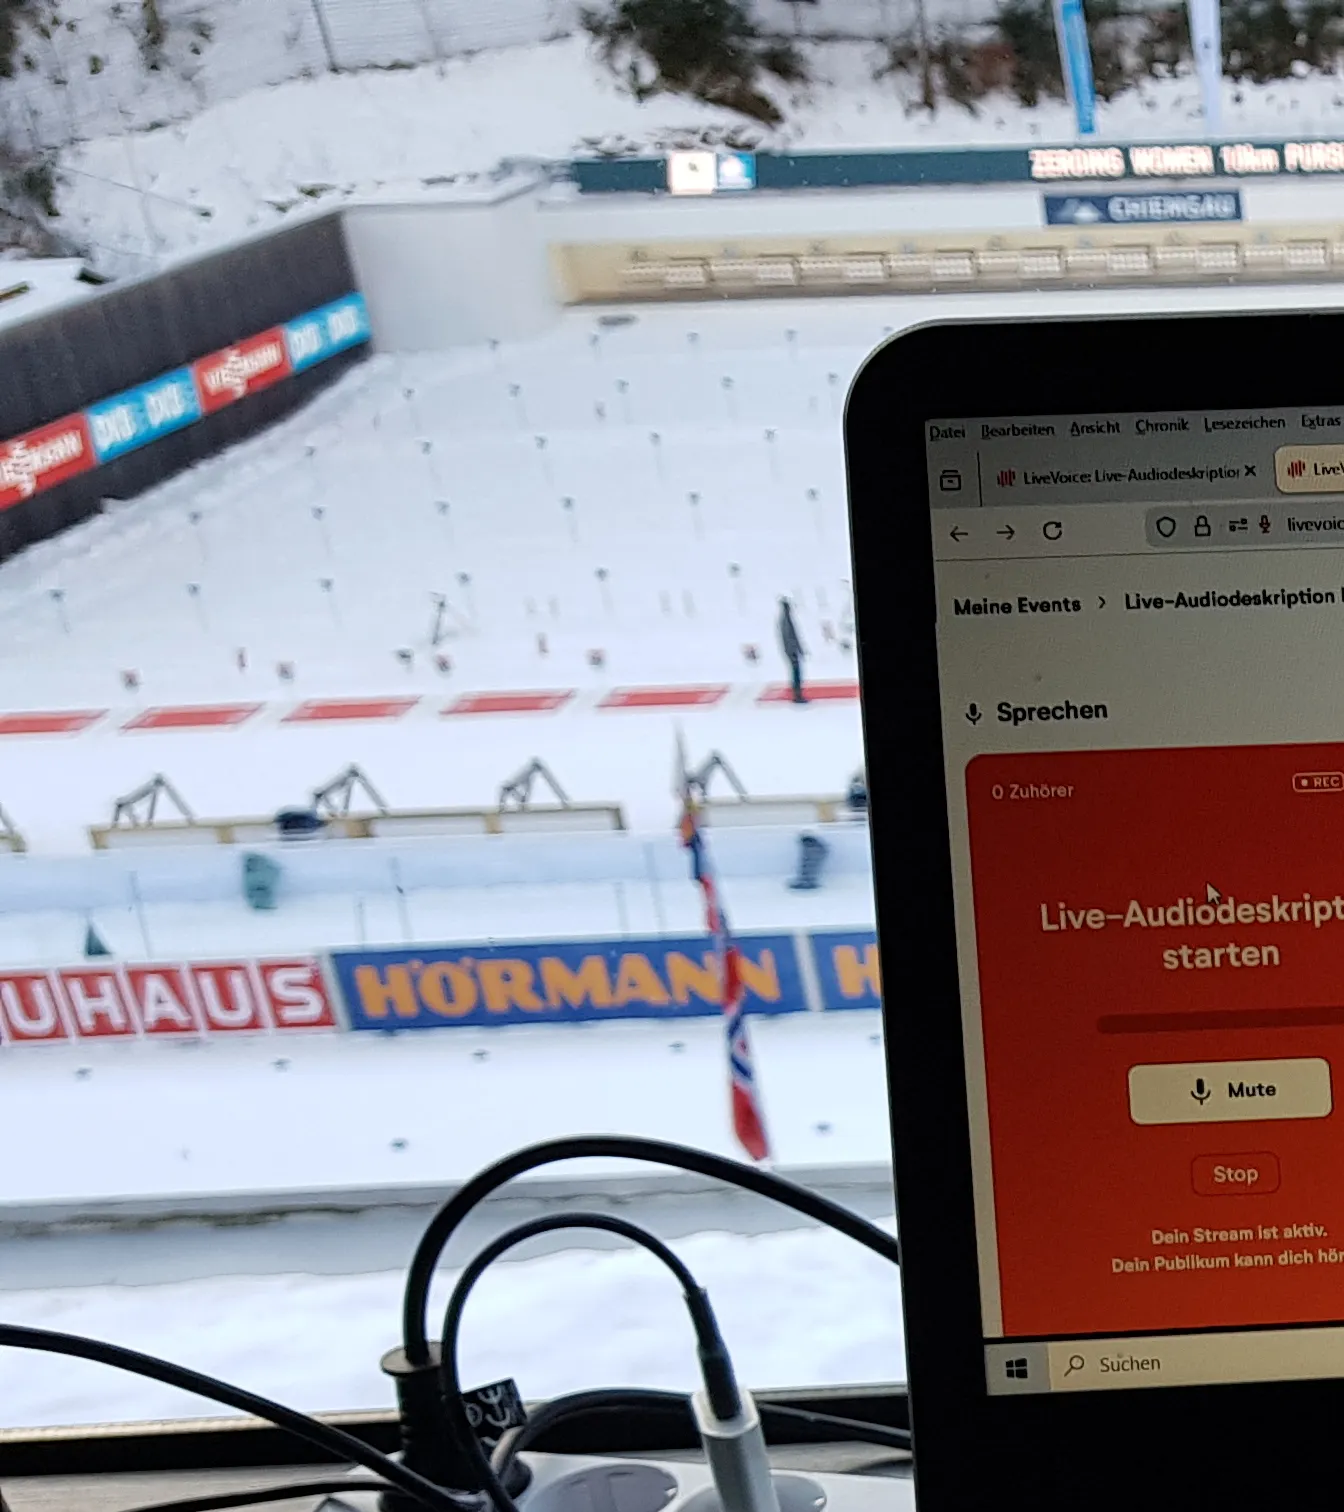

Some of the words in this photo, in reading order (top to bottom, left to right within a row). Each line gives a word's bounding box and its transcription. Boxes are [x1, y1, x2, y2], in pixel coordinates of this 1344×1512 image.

[929, 425, 966, 441] Datei
[981, 424, 1055, 440] Bearbeiten
[1070, 421, 1121, 438] Ansicht
[1135, 418, 1190, 435] Chronik
[1204, 416, 1286, 433] Lesezeichen
[1301, 414, 1342, 430] Extras
[1023, 470, 1092, 486] LiveVoice:
[953, 598, 1012, 616] Meine
[1017, 596, 1081, 613] Events
[1124, 586, 1335, 610] Live-Audiodeskription
[996, 700, 1108, 727] Sprechen
[1009, 781, 1074, 799] Zuhörer
[1313, 775, 1341, 789] REC
[1162, 940, 1281, 970] starten
[354, 947, 782, 1018] HÖRMANN
[0, 966, 323, 1035] UHAUS
[1227, 1082, 1277, 1099] Mute
[1212, 1165, 1259, 1186] Stop
[1151, 1228, 1190, 1245] Dein
[1193, 1226, 1254, 1244] Stream
[1258, 1225, 1279, 1240] ist
[1283, 1223, 1328, 1239] aktiv.
[1111, 1258, 1150, 1274] Dein
[1153, 1254, 1230, 1272] Publikum
[1234, 1252, 1274, 1267] kann
[1278, 1250, 1314, 1266] dich
[1099, 1354, 1161, 1374] Suchen
